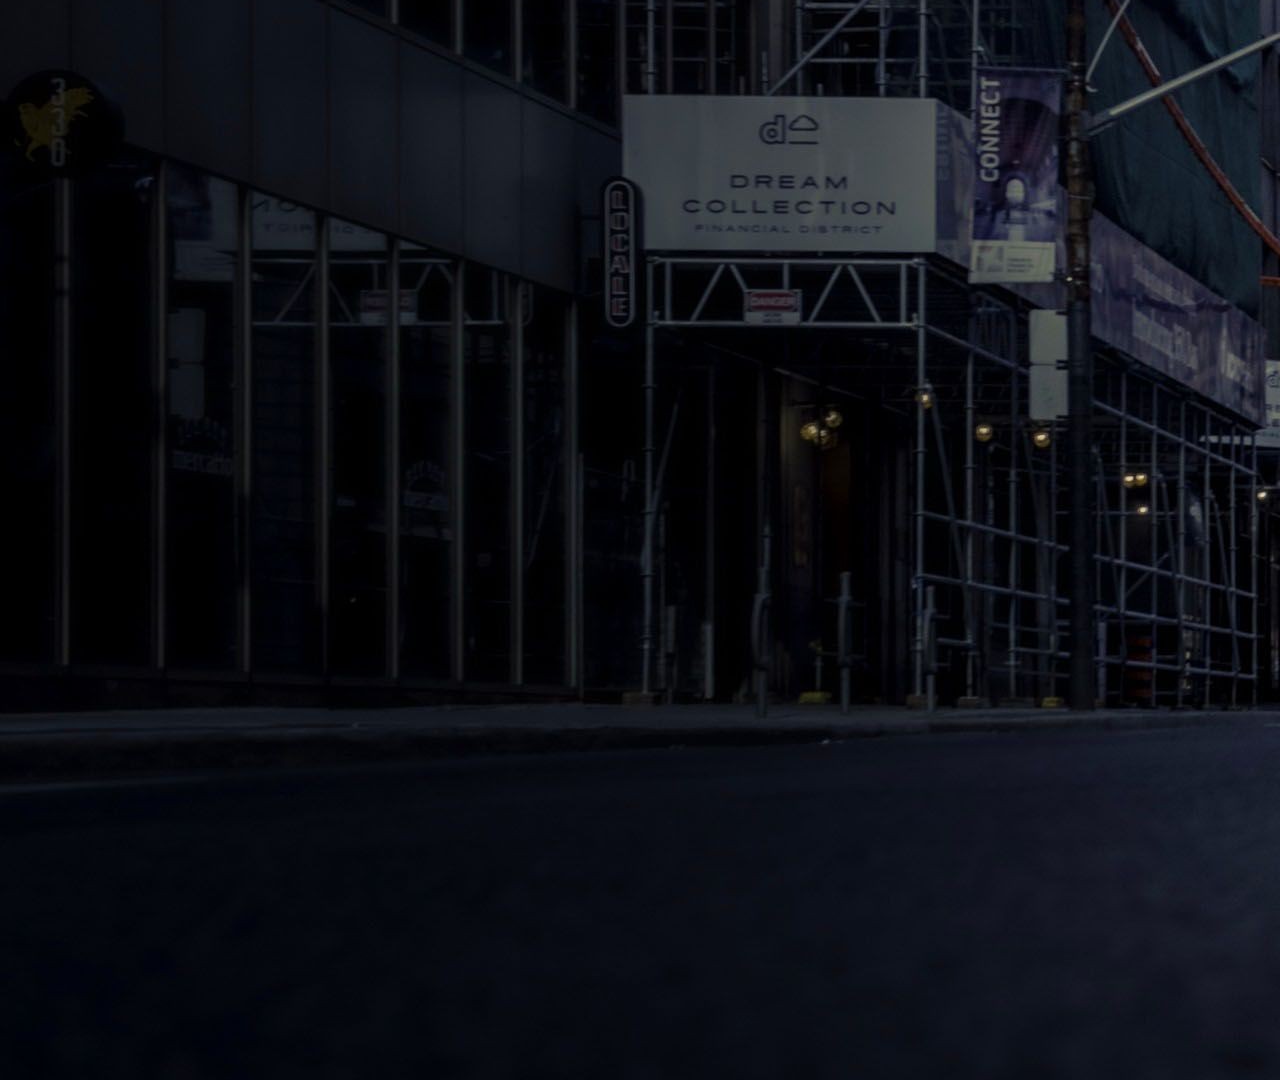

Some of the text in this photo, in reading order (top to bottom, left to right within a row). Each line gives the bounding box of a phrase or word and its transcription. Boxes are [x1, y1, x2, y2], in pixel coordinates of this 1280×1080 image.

[51, 77, 66, 168] 330
[978, 76, 1001, 182] CONNECT
[729, 174, 848, 190] DREAM
[682, 199, 896, 216] COLLECTION
[694, 224, 884, 235] FINANCIAL DISTRICT
